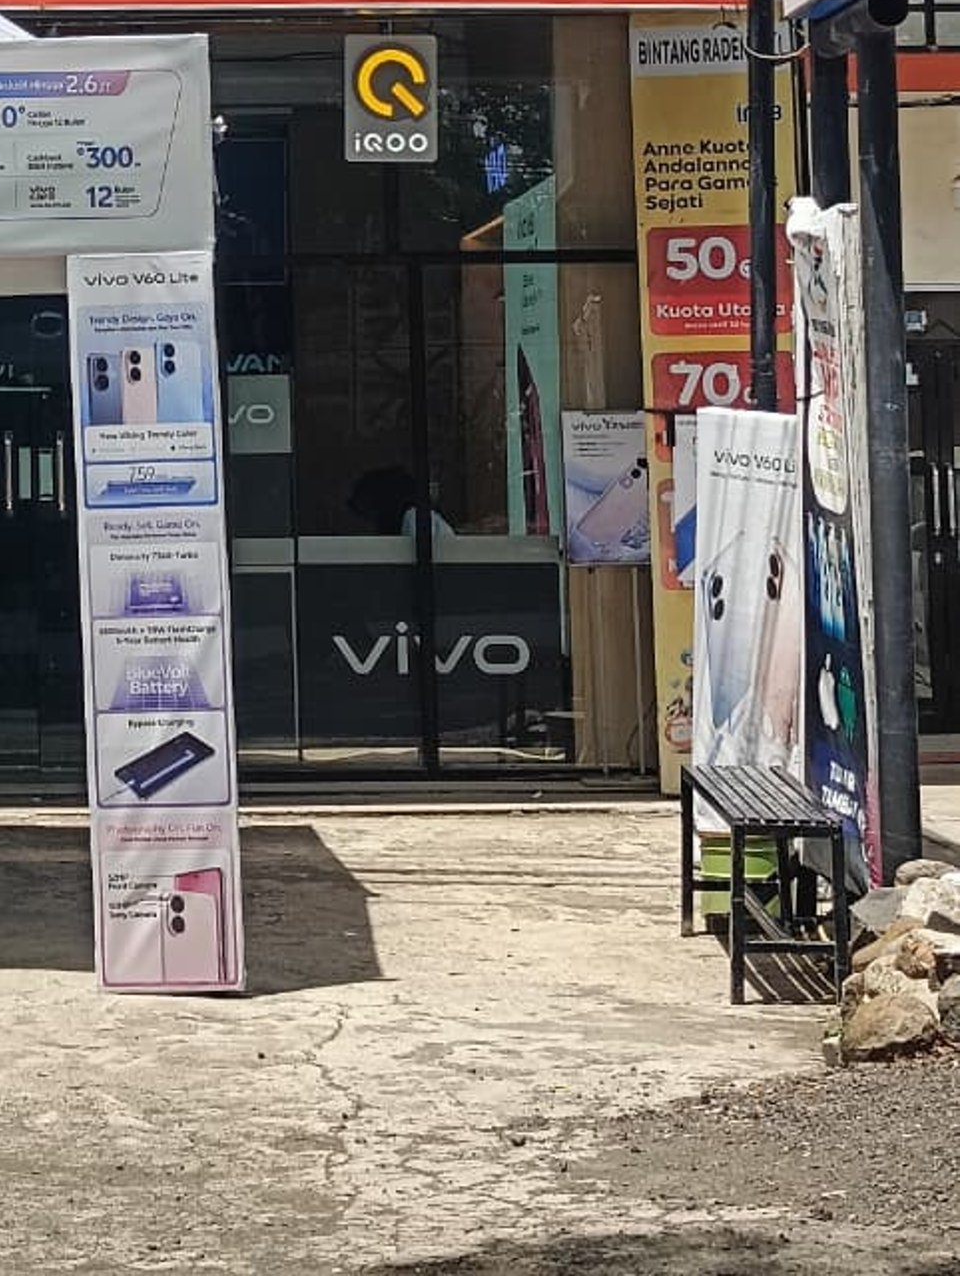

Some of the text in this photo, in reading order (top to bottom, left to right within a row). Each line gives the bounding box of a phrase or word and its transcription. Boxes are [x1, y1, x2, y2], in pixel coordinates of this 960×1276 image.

[638, 39, 700, 64] BINTANG
[66, 75, 98, 93] 2.6
[354, 132, 428, 153] iQOO
[699, 139, 751, 155] Kuot
[646, 176, 693, 191] Para
[86, 186, 113, 208] 12
[646, 193, 703, 213] Sejati
[84, 273, 129, 286] vivo
[169, 272, 199, 284] Lite
[656, 303, 714, 319] Kuota
[714, 449, 752, 467] vivo
[332, 621, 531, 675] vivo
[129, 680, 190, 697] Battery
